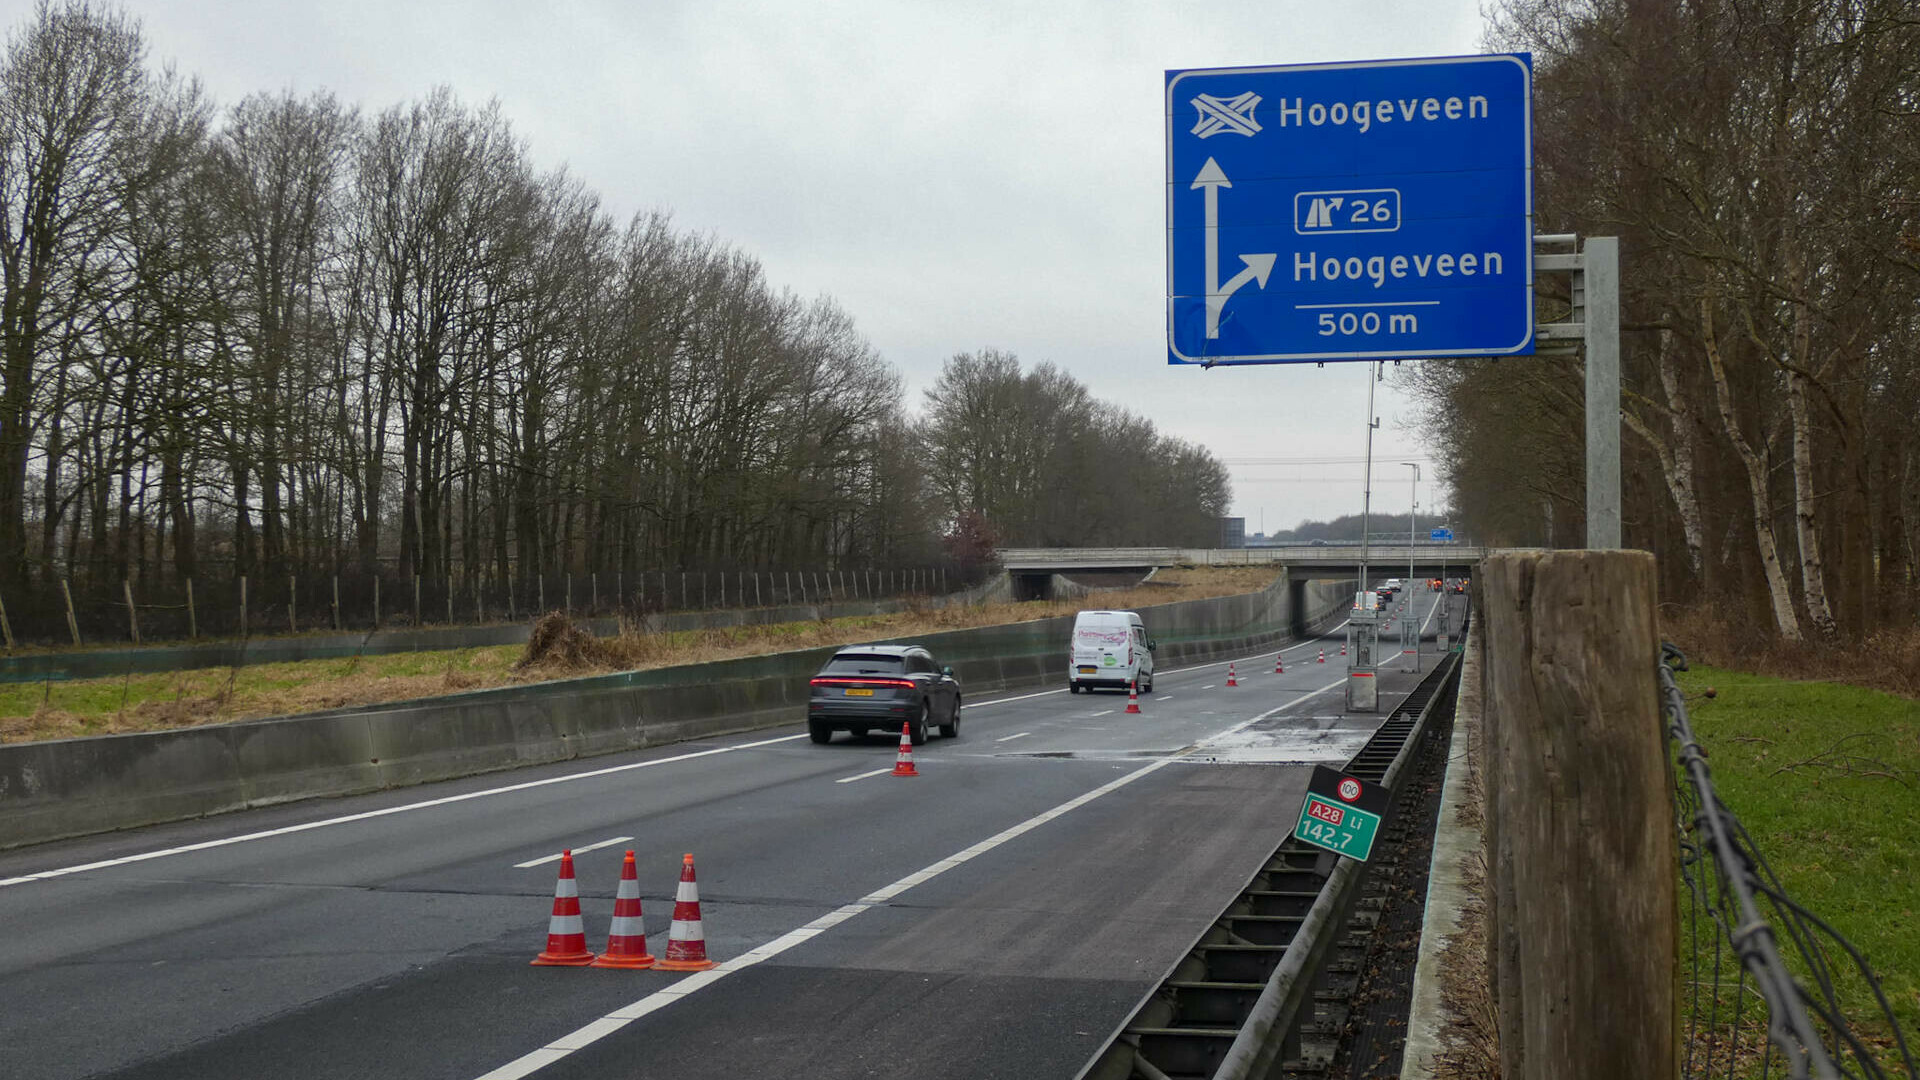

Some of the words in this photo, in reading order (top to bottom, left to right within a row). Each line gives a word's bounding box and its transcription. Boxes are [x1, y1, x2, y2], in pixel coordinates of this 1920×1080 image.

[1280, 95, 1488, 133] Hoogeveen
[1350, 199, 1391, 223] 26
[1294, 251, 1503, 288] Hoogeveen
[1318, 312, 1381, 336] 500
[1390, 313, 1417, 333] m
[1342, 783, 1358, 796] 100
[1312, 804, 1340, 822] A28
[1350, 816, 1363, 830] Li
[1303, 820, 1353, 849] 142,7
